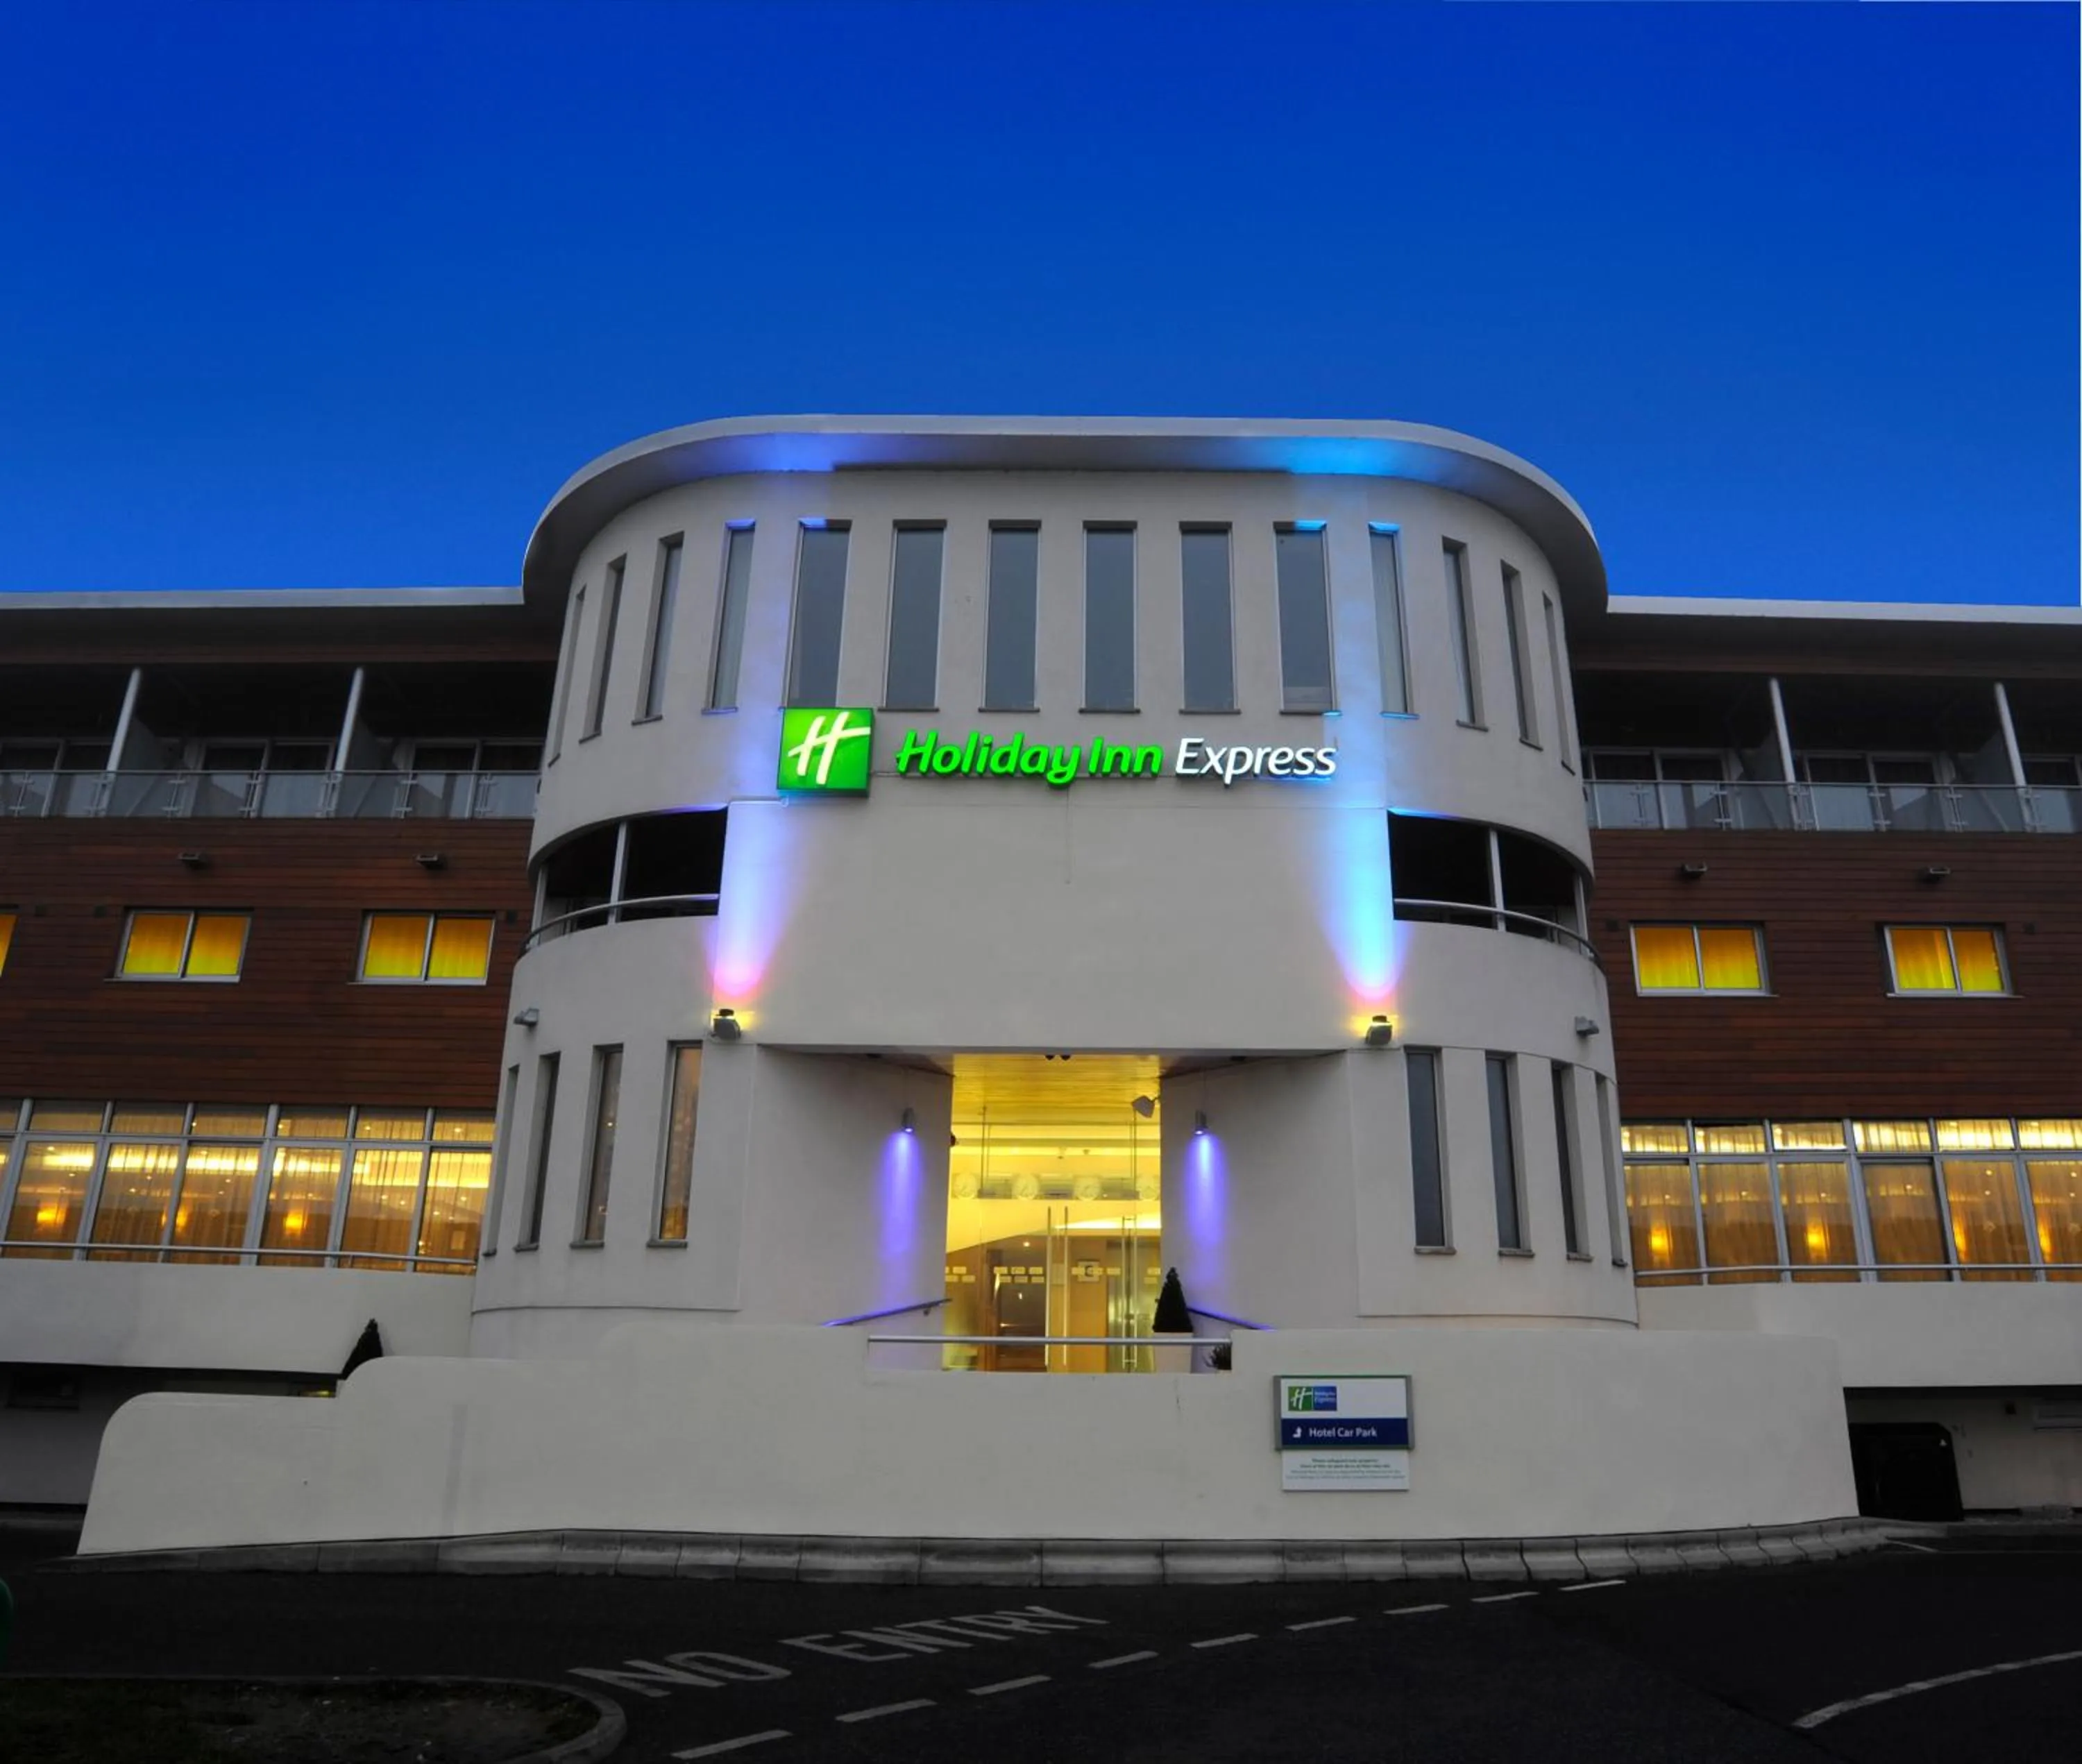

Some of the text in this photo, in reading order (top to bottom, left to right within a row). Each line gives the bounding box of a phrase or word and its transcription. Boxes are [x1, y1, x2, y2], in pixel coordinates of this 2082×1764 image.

[896, 729, 1337, 786] Holiday Inn Express
[1309, 1426, 1378, 1437] Hotel Car Park
[568, 1606, 1111, 1697] NO ENTRY
